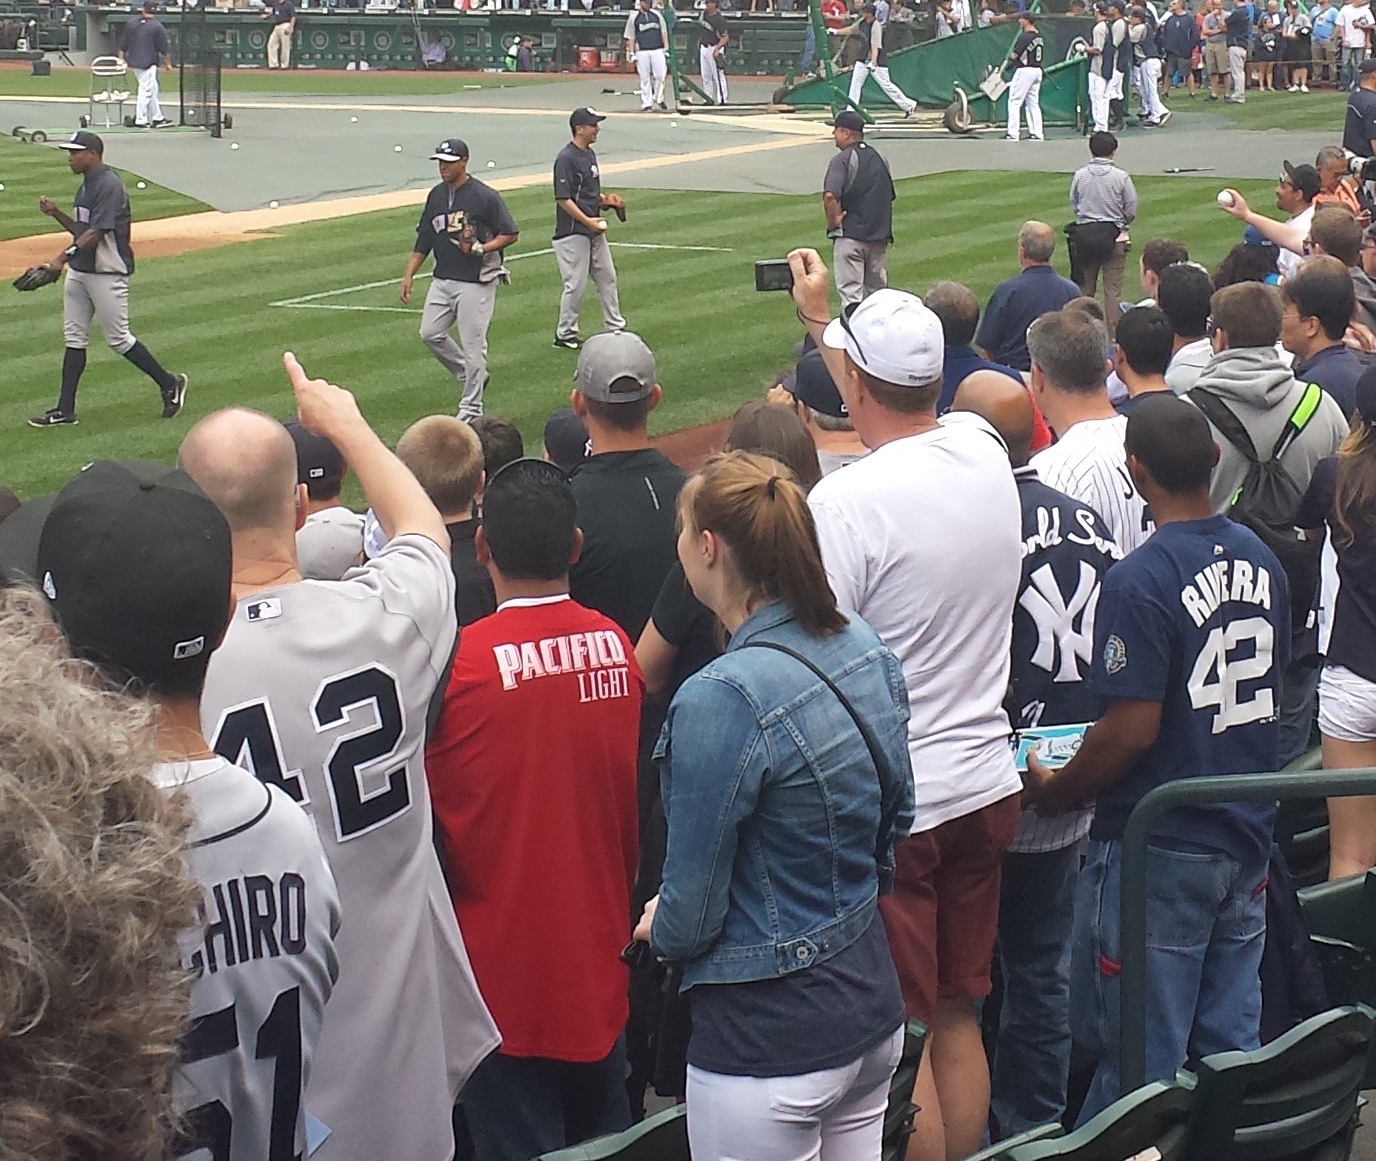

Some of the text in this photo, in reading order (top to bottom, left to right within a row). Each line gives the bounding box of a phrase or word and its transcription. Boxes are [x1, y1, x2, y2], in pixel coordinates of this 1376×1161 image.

[1181, 559, 1271, 628] RIVERA
[492, 630, 628, 691] PACIFICO
[577, 667, 629, 703] LIGHT
[1186, 616, 1274, 734] 42
[210, 661, 413, 843] 42
